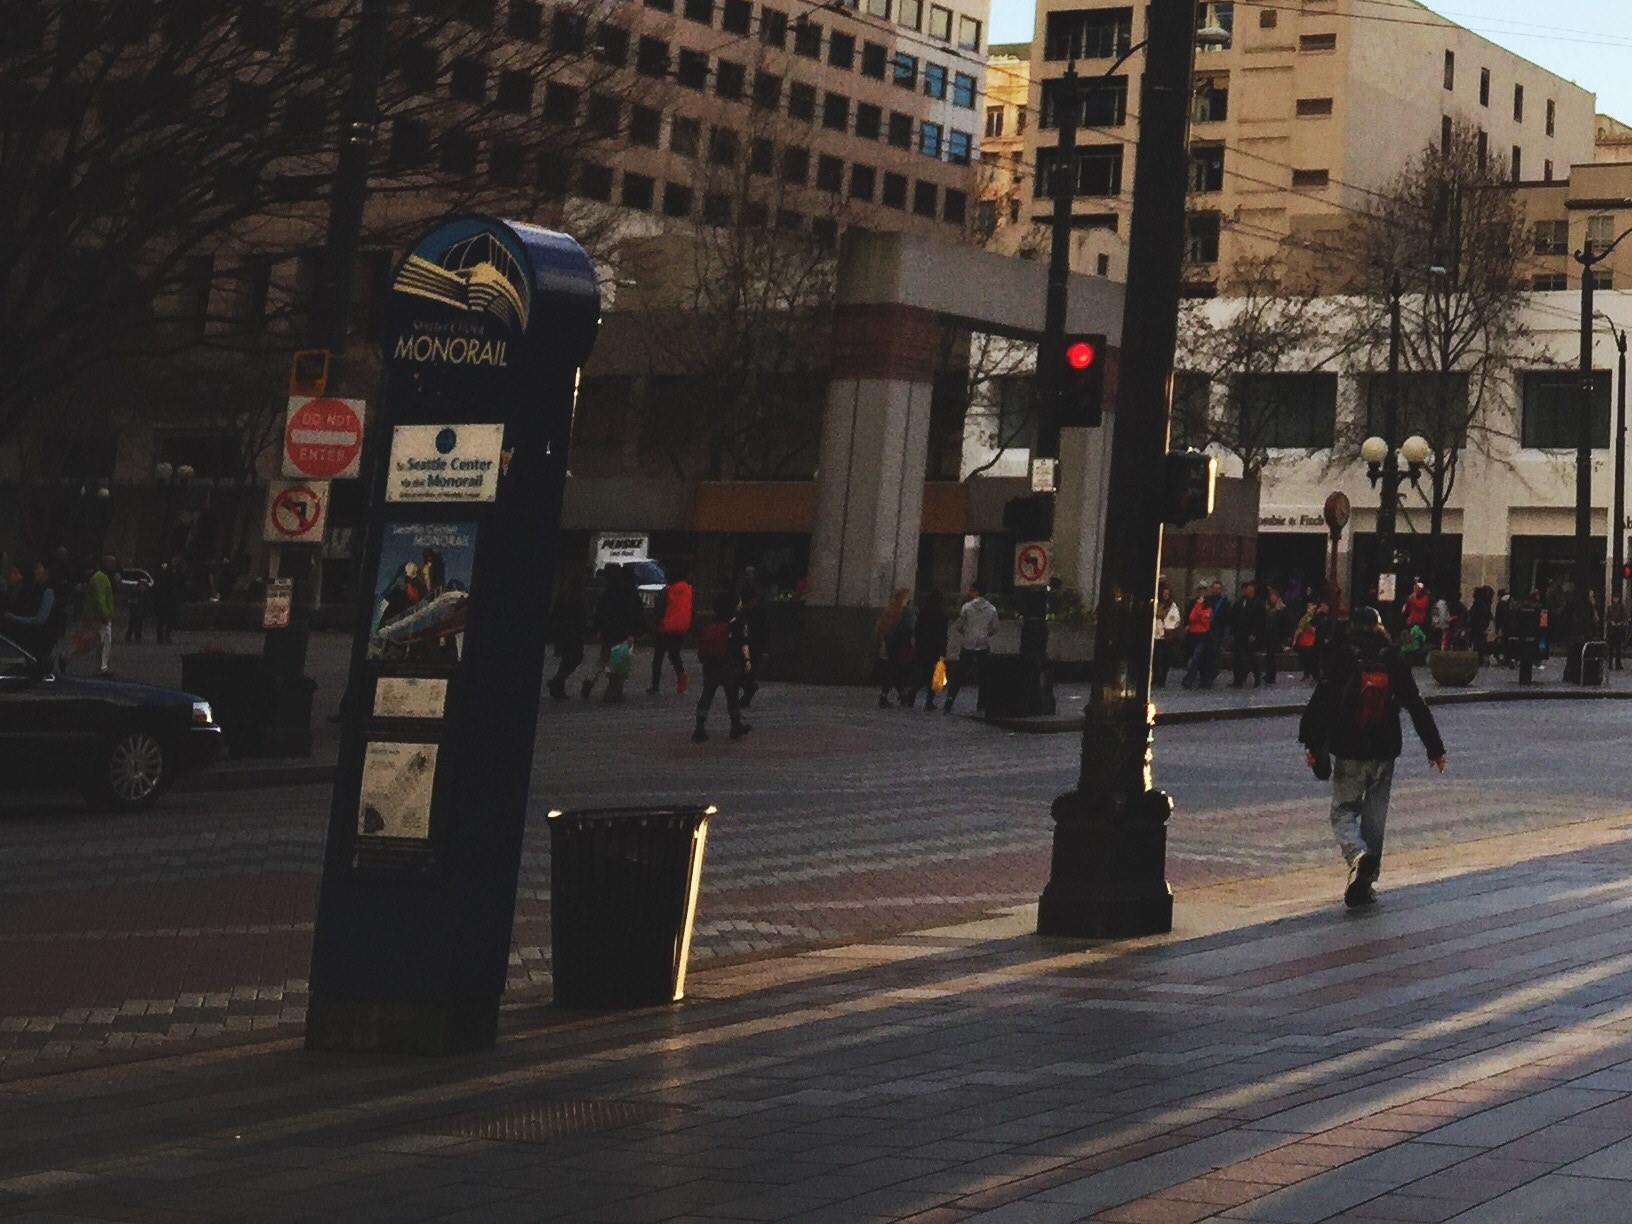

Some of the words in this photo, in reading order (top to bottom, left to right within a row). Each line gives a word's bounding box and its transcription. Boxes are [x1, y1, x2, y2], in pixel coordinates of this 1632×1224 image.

[393, 335, 508, 367] MONORAIL
[302, 412, 321, 426] DO
[326, 413, 352, 427] NOT
[299, 446, 346, 462] ENTER
[407, 457, 448, 471] Seattle
[451, 457, 493, 471] Center
[427, 473, 484, 488] Monorail
